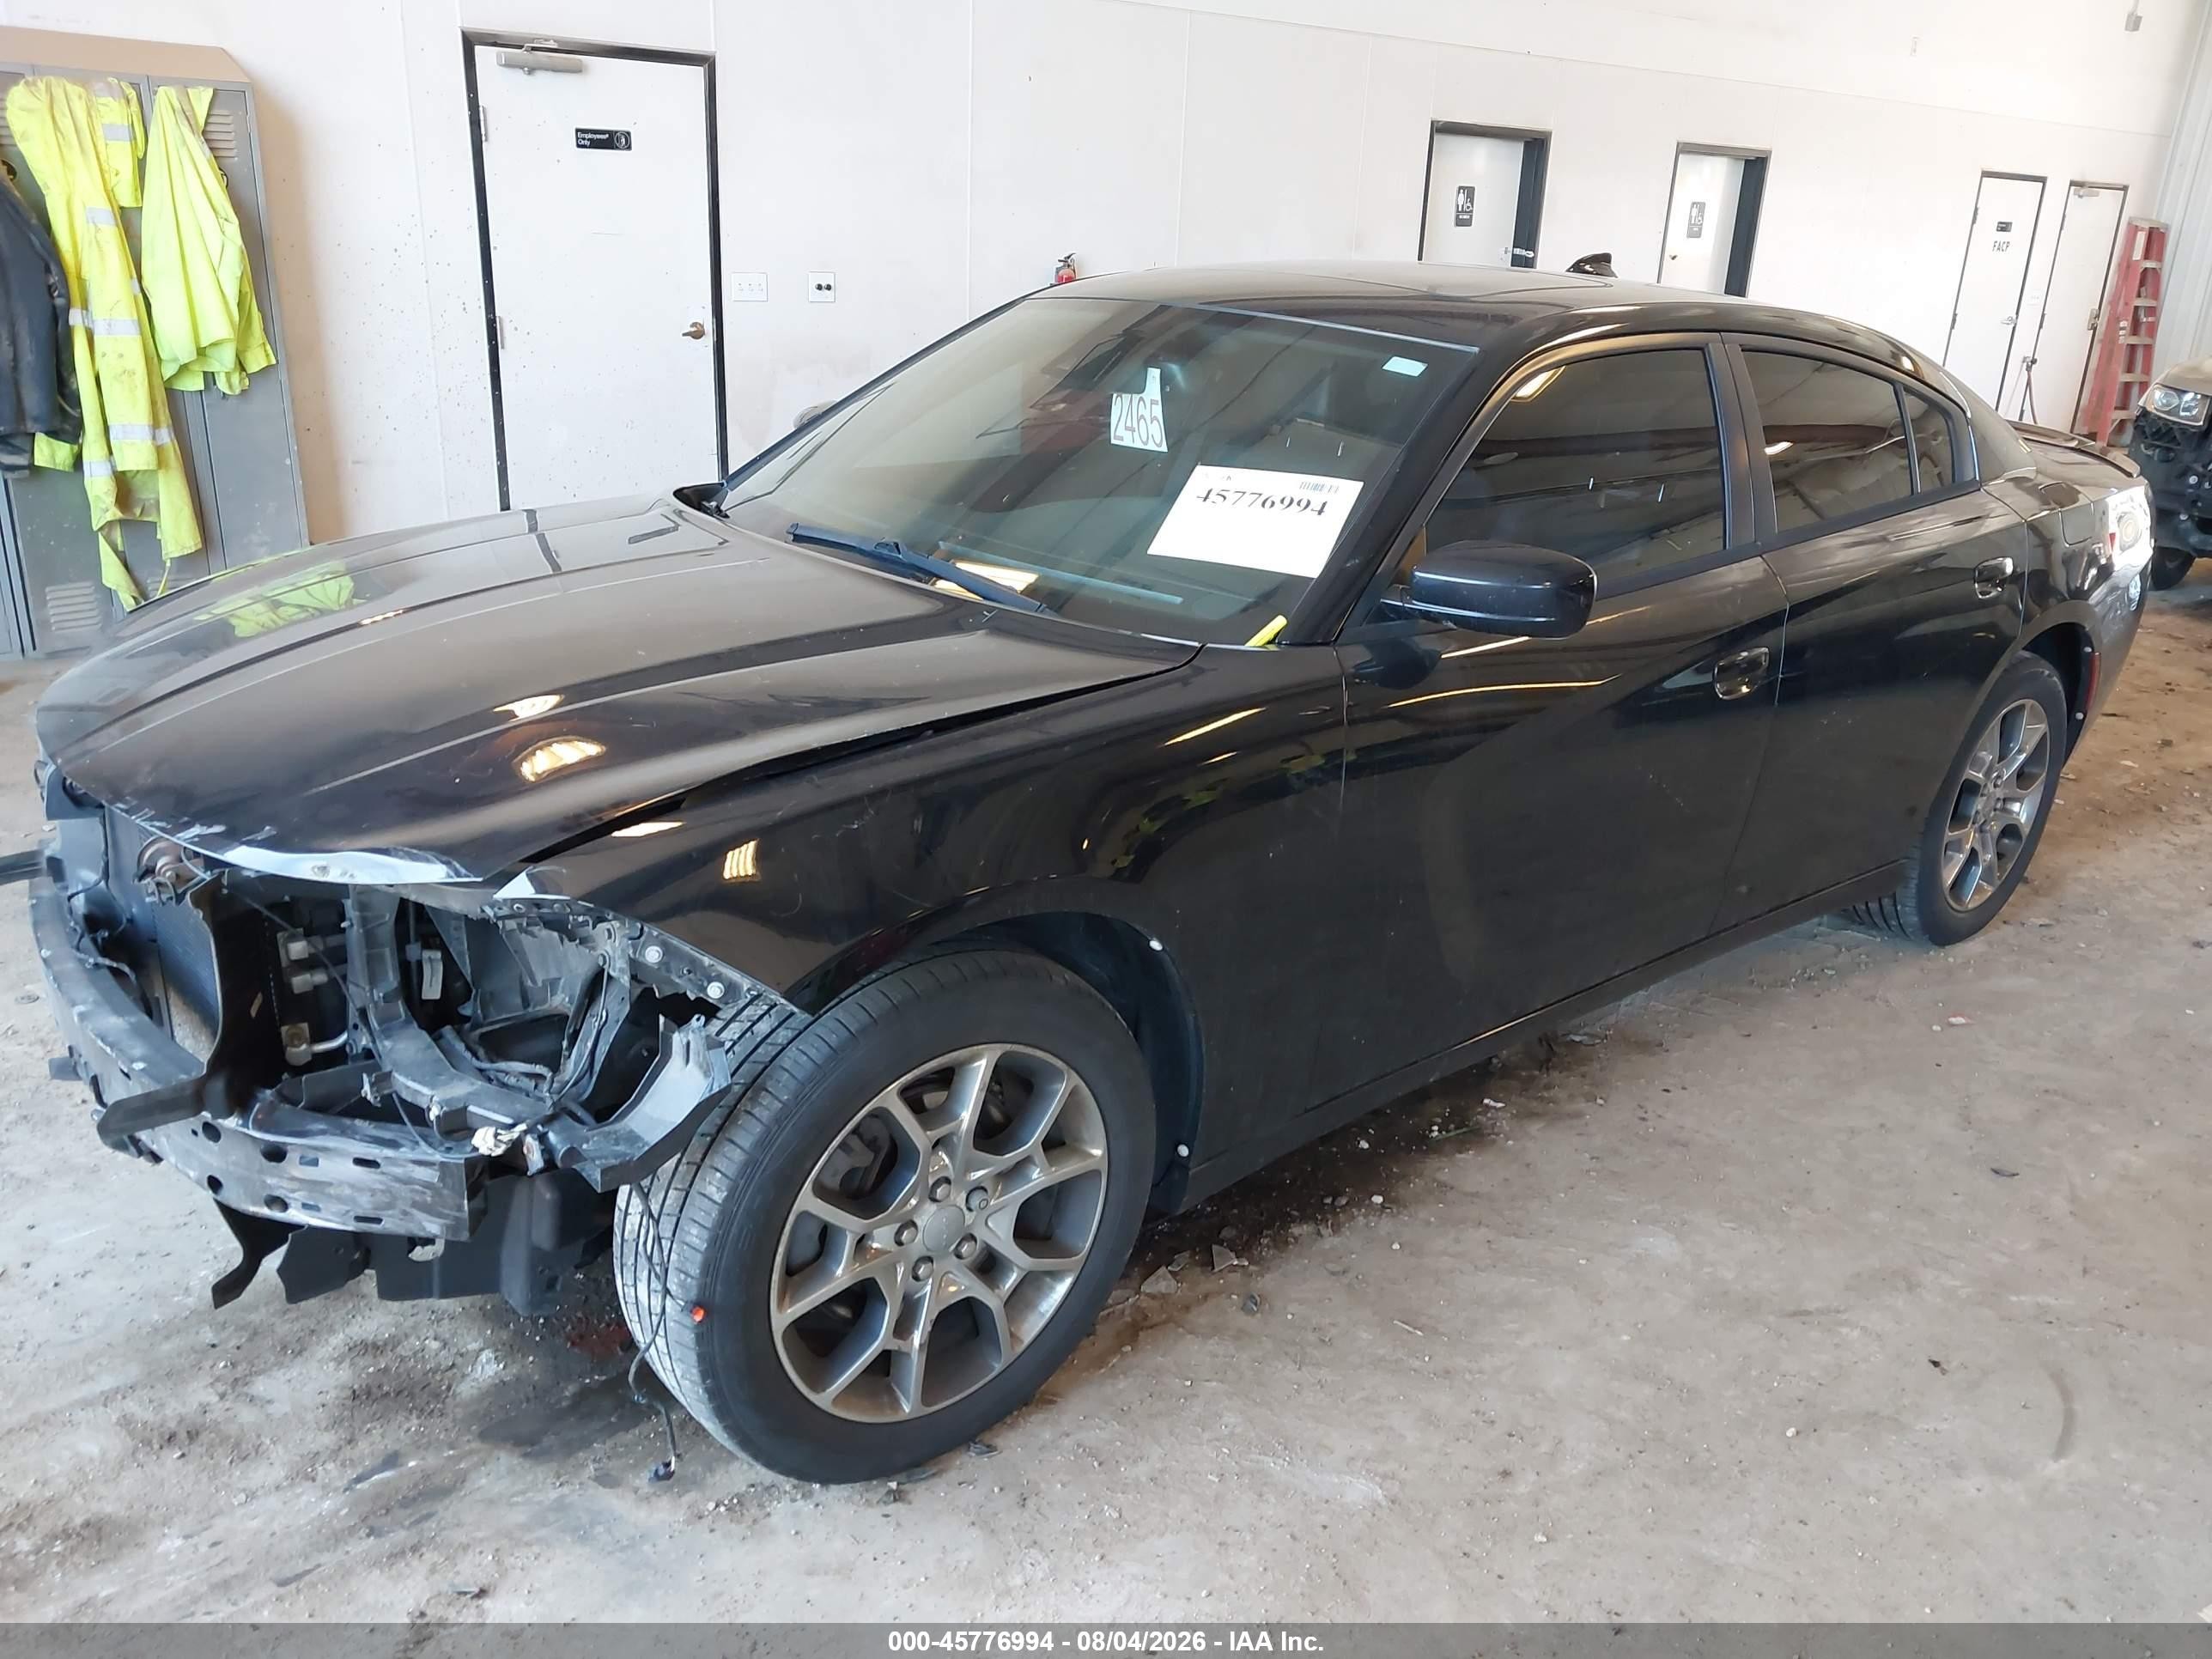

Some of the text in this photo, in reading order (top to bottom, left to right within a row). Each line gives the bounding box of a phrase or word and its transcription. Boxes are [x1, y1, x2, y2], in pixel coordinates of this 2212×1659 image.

[1992, 240, 2010, 252] FACP
[1113, 393, 1164, 448] 2465
[1196, 488, 1328, 515] 45776994
